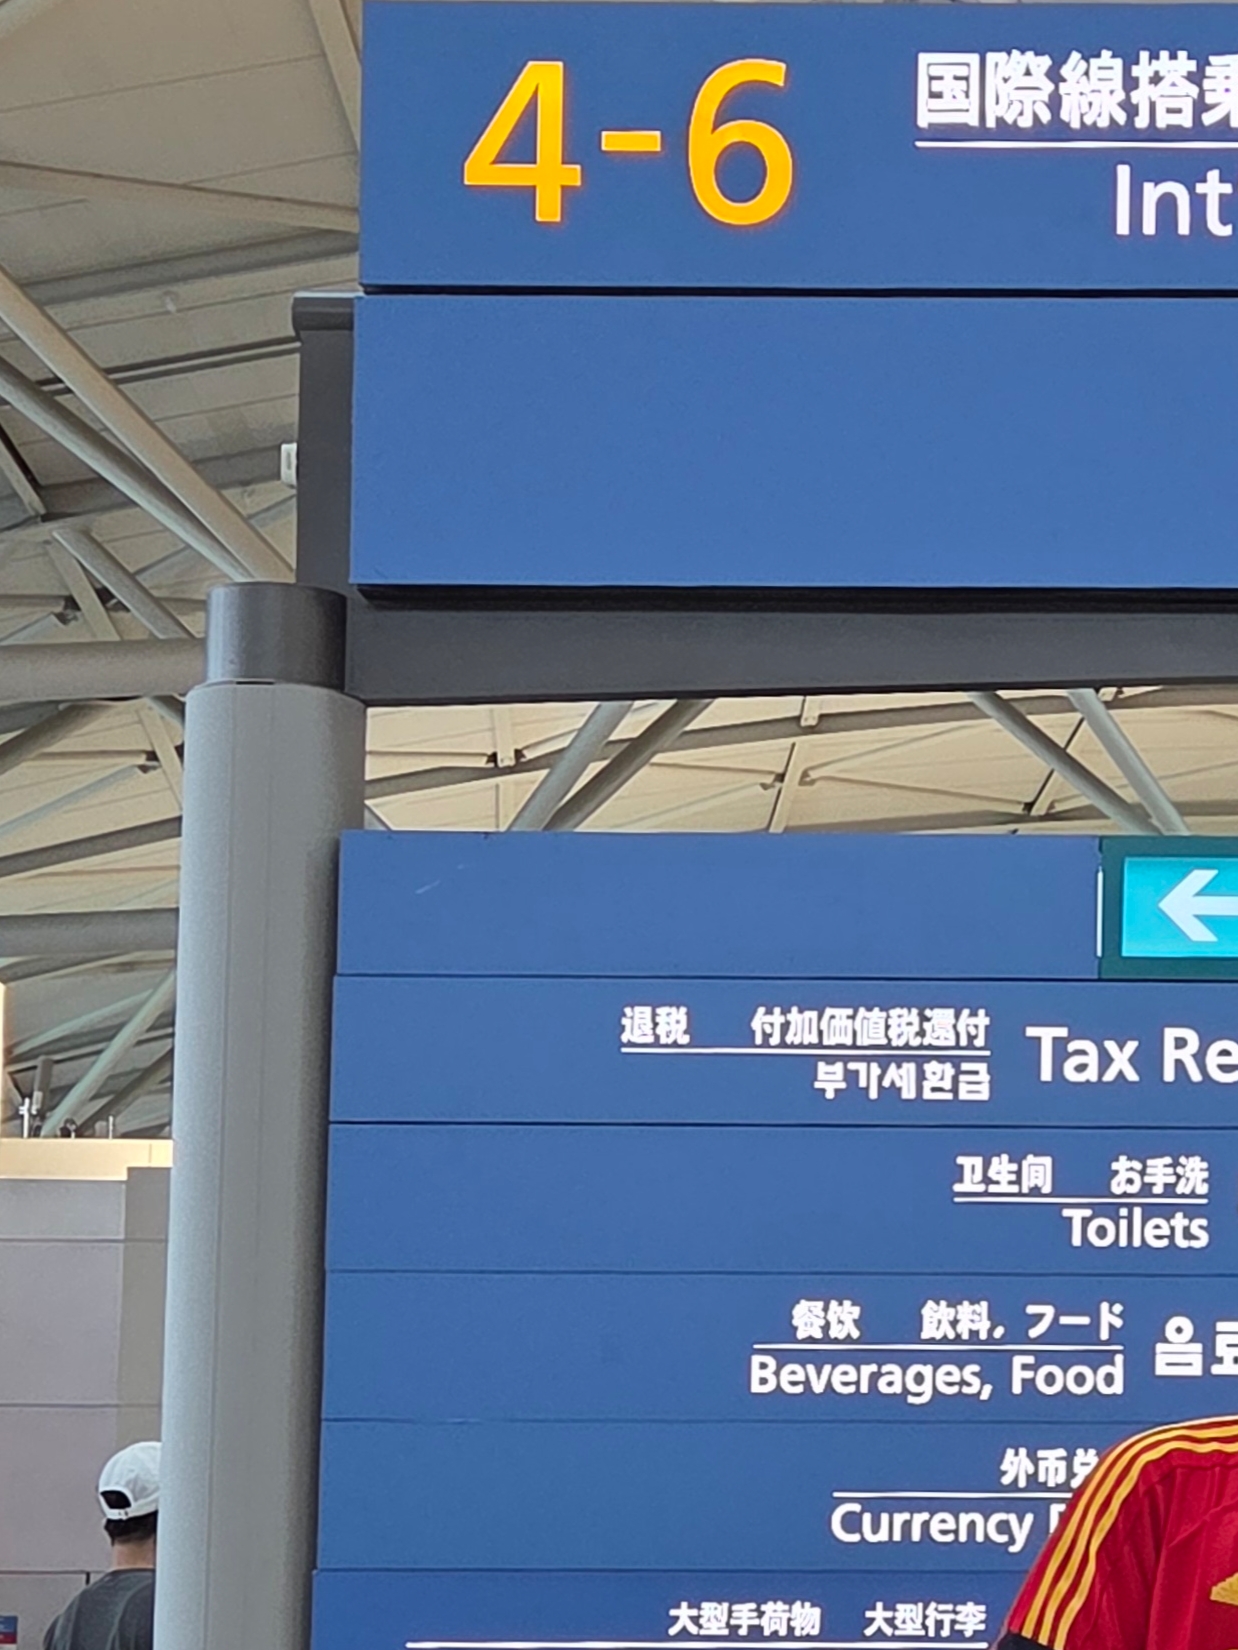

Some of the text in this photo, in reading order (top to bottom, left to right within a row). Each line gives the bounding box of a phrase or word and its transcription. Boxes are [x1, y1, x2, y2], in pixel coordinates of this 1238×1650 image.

[465, 61, 793, 226] 4-6
[620, 1005, 990, 1047] 退税 付加価値税還付
[1025, 1026, 1140, 1083] Tax
[952, 1153, 1209, 1195] 卫生间 お手洗
[1061, 1206, 1209, 1249] Toilets
[791, 1299, 861, 1340] 餐饮
[750, 1353, 1124, 1405] Beverages, Food
[831, 1502, 1034, 1553] Currency
[668, 1600, 987, 1638] 大型手荷物 大型行李
